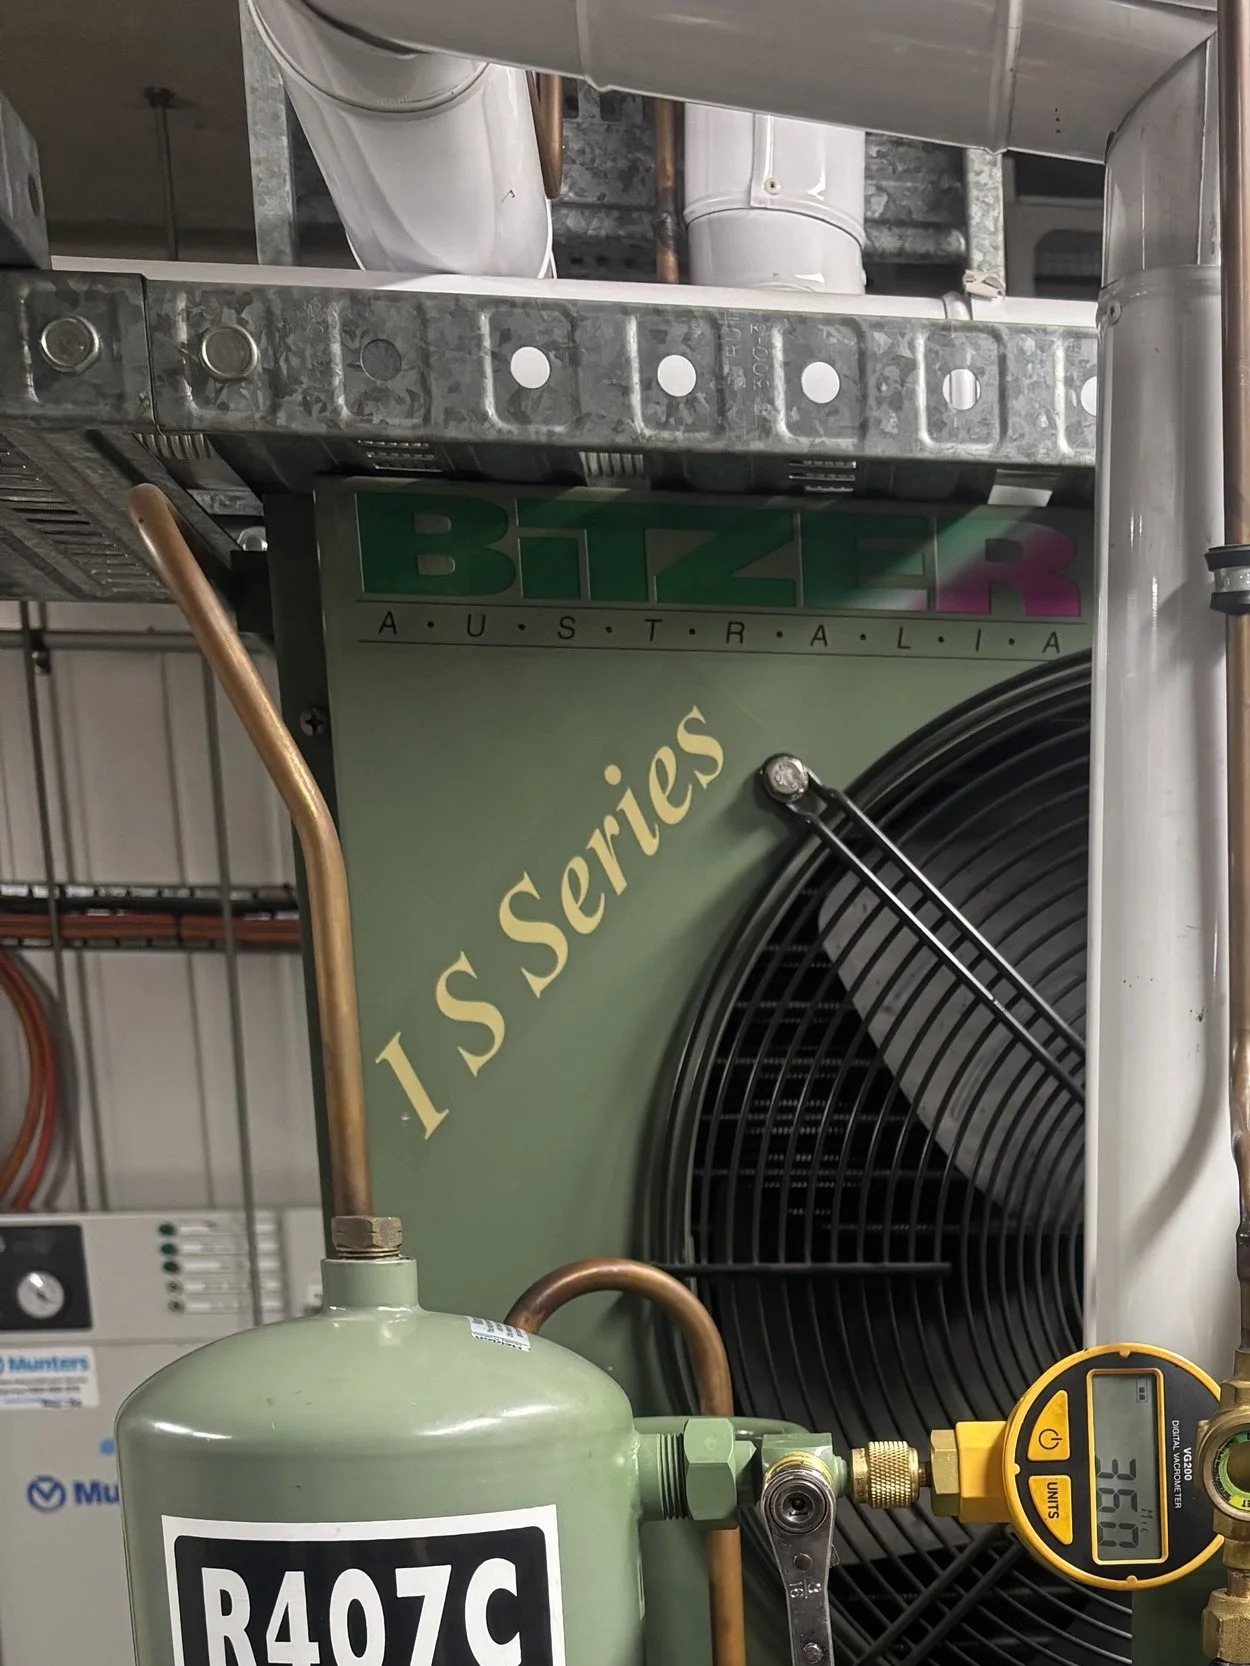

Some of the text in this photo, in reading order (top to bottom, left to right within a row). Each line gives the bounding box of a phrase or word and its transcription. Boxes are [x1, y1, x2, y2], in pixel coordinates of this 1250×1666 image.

[435, 952, 506, 1077] S
[497, 704, 725, 998] Series
[9, 1356, 89, 1373] Munters
[1171, 1420, 1182, 1509] DIGITAL VACROMETER
[1183, 1447, 1192, 1481] VG200
[1047, 1481, 1059, 1520] UNITS
